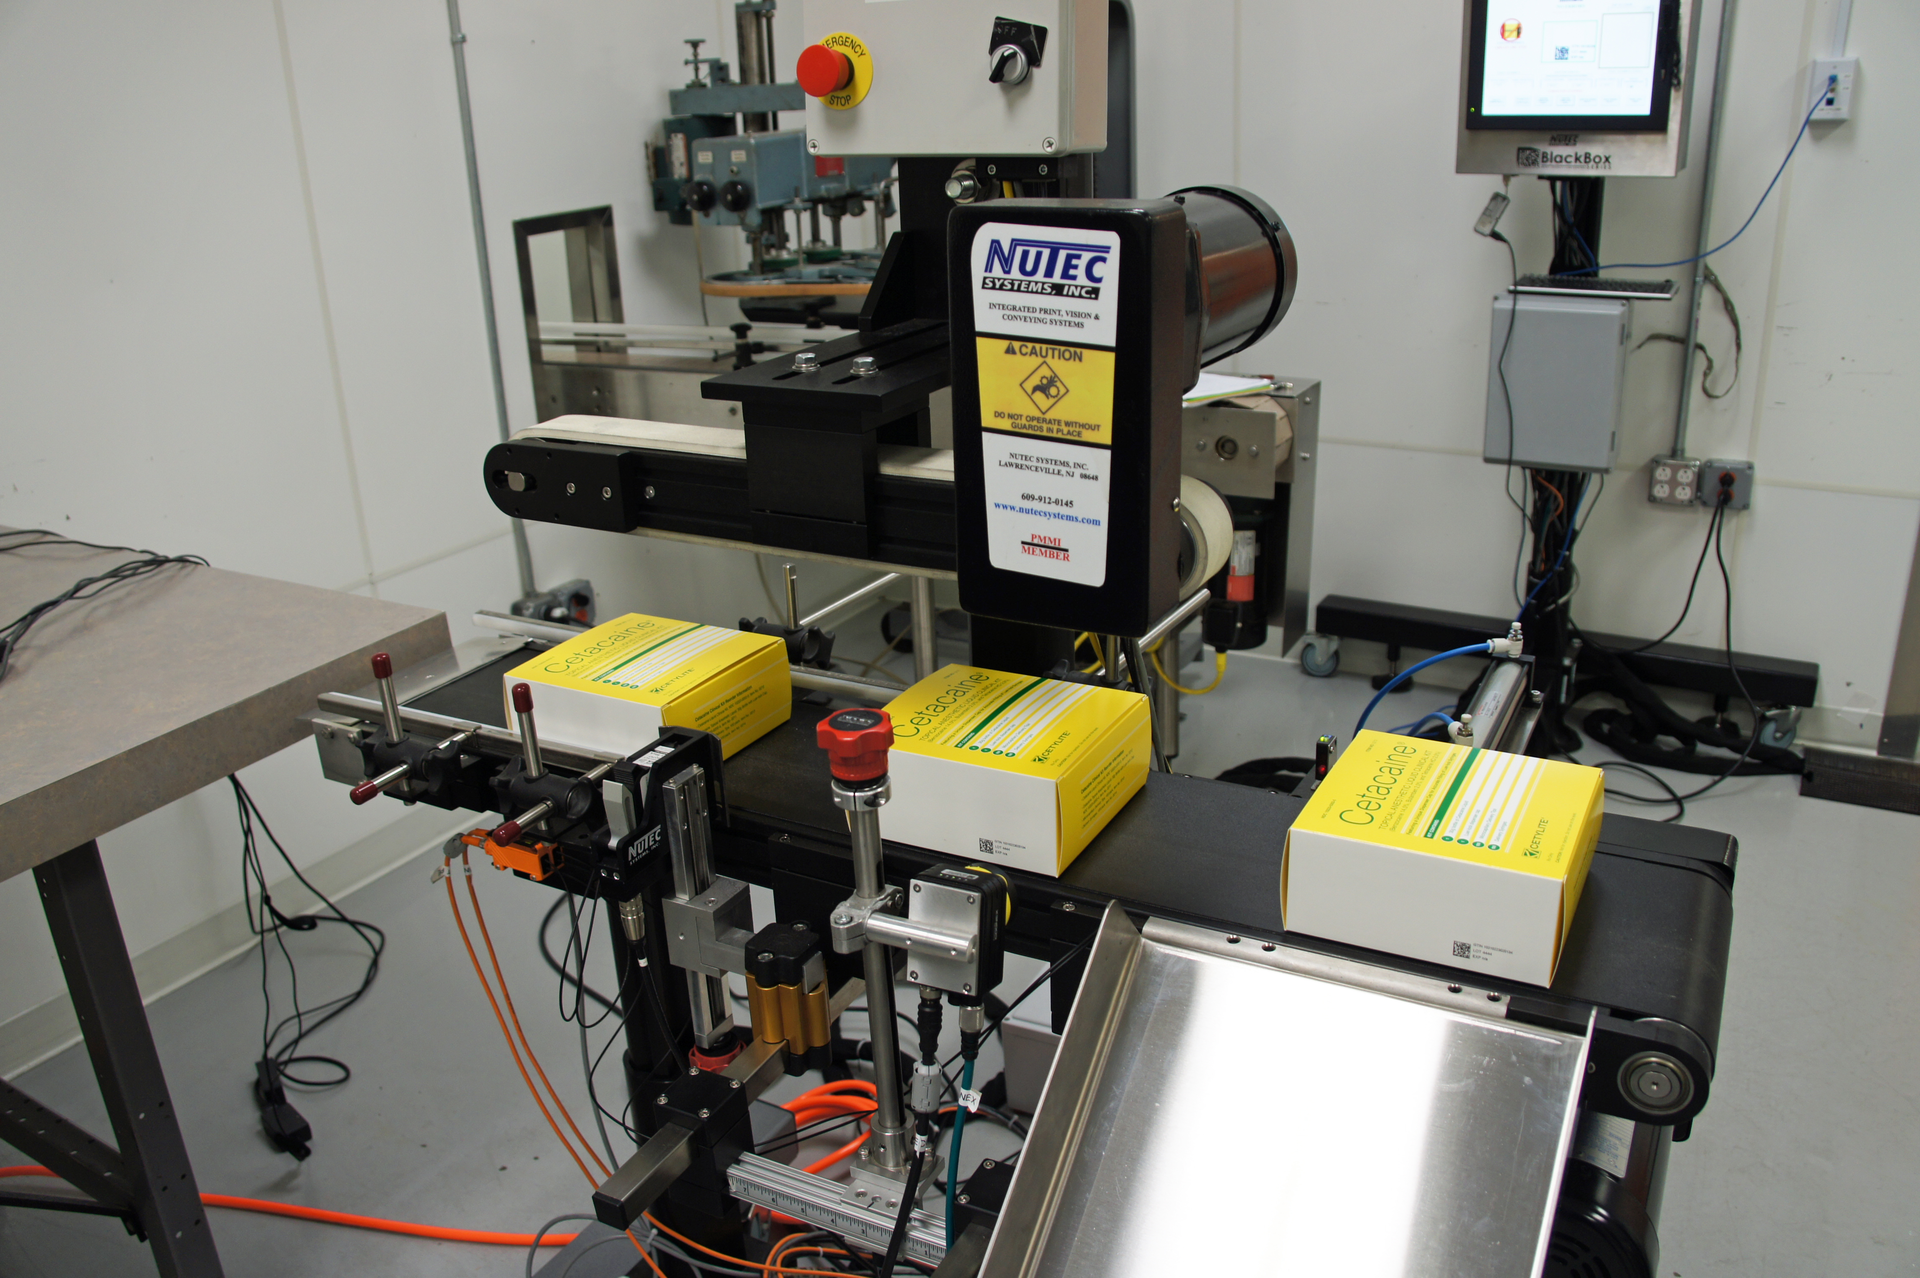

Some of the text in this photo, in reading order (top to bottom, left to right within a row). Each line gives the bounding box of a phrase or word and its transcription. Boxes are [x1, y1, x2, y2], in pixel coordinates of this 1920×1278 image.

[822, 35, 866, 58] ERGENCY
[829, 94, 852, 107] STOP
[1541, 151, 1612, 164] BlackBox
[984, 277, 1096, 298] SYSTEMS, INC.
[988, 302, 1100, 321] INTEGRATED PRINT, VISION &
[1002, 313, 1084, 329] CONVEYING SYSTEMS
[1018, 343, 1083, 362] CAUTION
[994, 410, 1101, 432] DO NOT OPERATE WITHOUT
[1011, 421, 1083, 438] GUARDS IN PLACE
[998, 460, 1099, 482] LAWRENCEVILLE, NJ 08648
[1009, 452, 1089, 471] NUTEC SYSTEMS, INC.
[1021, 492, 1074, 509] 609-912-0145
[993, 501, 1101, 527] www.nutecsystems.com
[1030, 533, 1062, 547] PMMI
[1021, 545, 1071, 562] MEMBER
[544, 620, 653, 674] Cetacaine
[660, 669, 694, 690] CETYLITE
[892, 673, 990, 738] Cetacaine
[1042, 731, 1069, 757] CETYLITE
[1339, 744, 1417, 827] Cetacaine
[628, 824, 661, 861] NUTEC
[1530, 818, 1549, 850] CETYLITE
